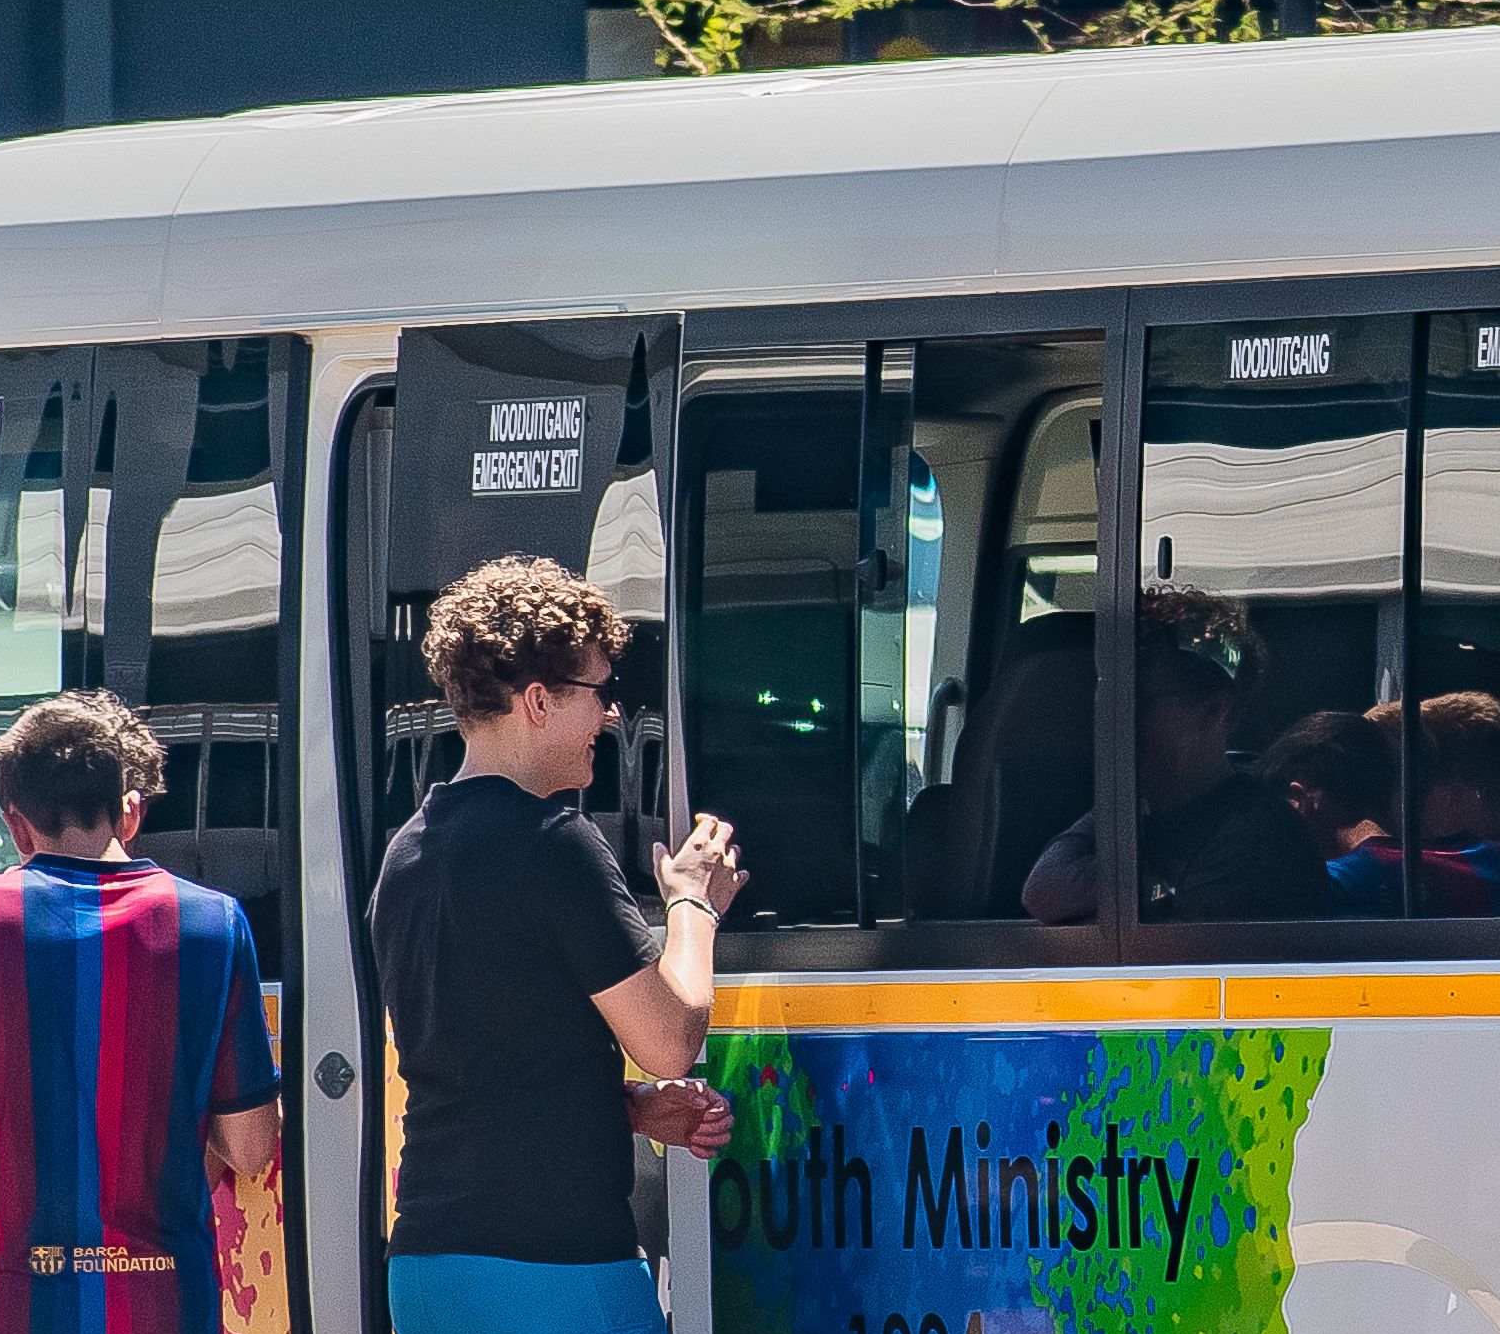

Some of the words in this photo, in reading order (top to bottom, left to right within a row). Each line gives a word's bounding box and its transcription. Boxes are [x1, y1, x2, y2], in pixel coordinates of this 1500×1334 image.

[1230, 333, 1330, 378] NOODUITGANG
[490, 400, 581, 442] NOODUITGANG
[472, 450, 550, 490] EMERGENCY
[550, 449, 579, 487] EXIT
[710, 1124, 873, 1251] outh
[903, 1120, 1200, 1283] Ministry
[73, 1256, 176, 1273] FOUNDATION
